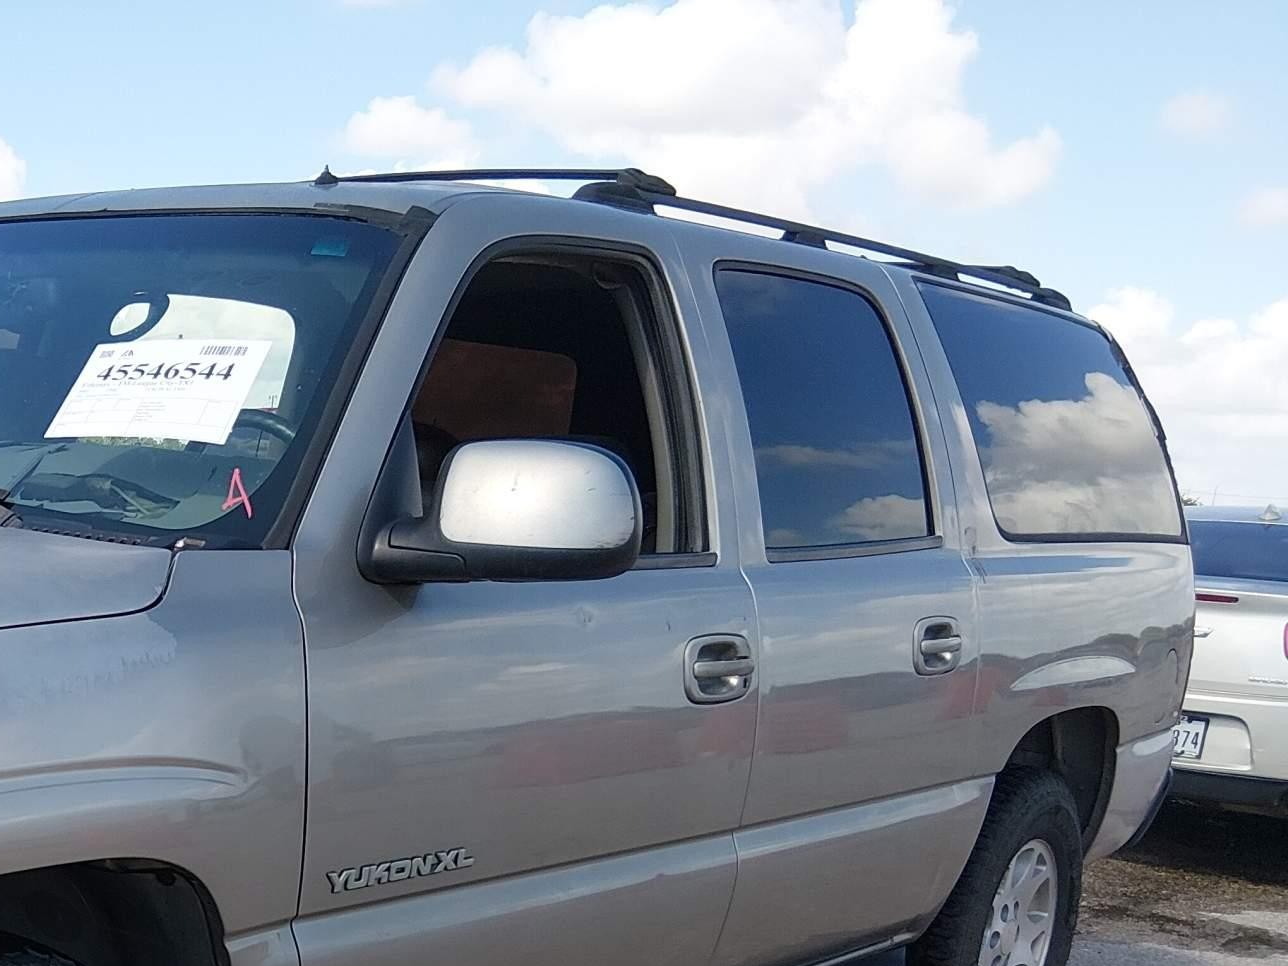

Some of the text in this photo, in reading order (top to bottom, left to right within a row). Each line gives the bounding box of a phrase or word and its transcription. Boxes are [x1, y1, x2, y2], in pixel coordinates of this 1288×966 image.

[96, 361, 236, 381] 45546544
[327, 846, 476, 893] YUKON XL
